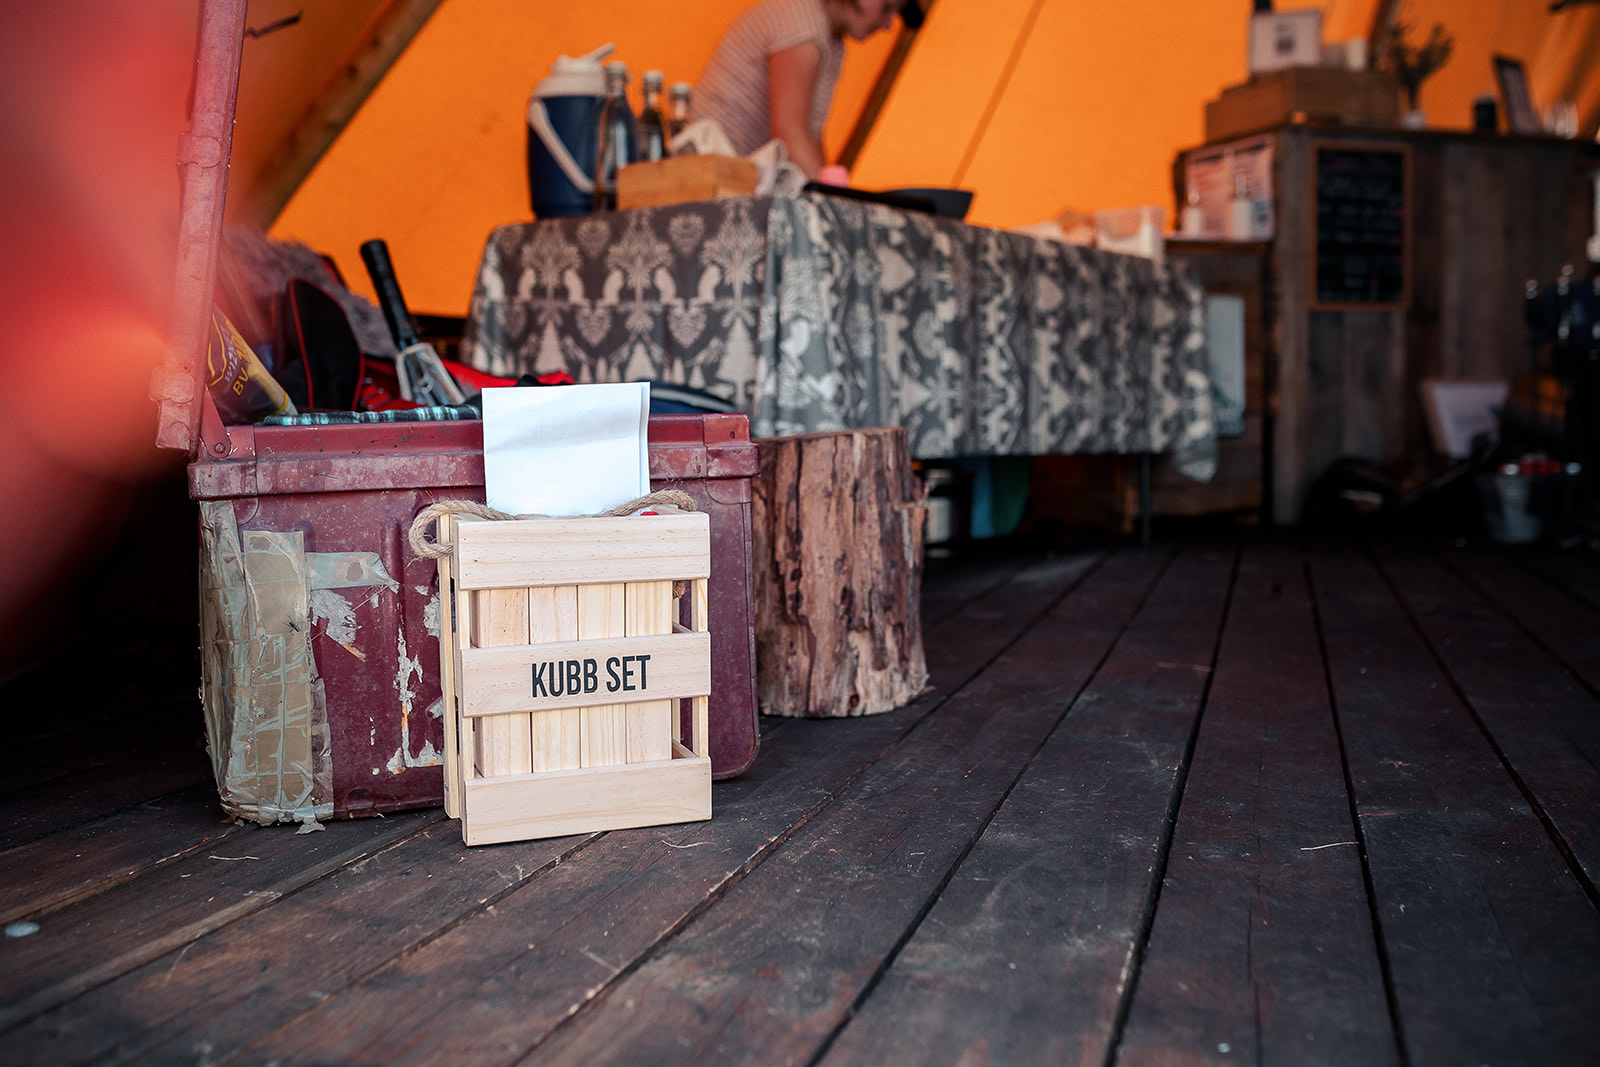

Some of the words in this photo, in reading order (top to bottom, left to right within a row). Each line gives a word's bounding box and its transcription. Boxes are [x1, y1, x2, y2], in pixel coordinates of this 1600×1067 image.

[232, 367, 249, 396] BV
[532, 658, 598, 698] KUBB
[606, 654, 651, 693] SET
